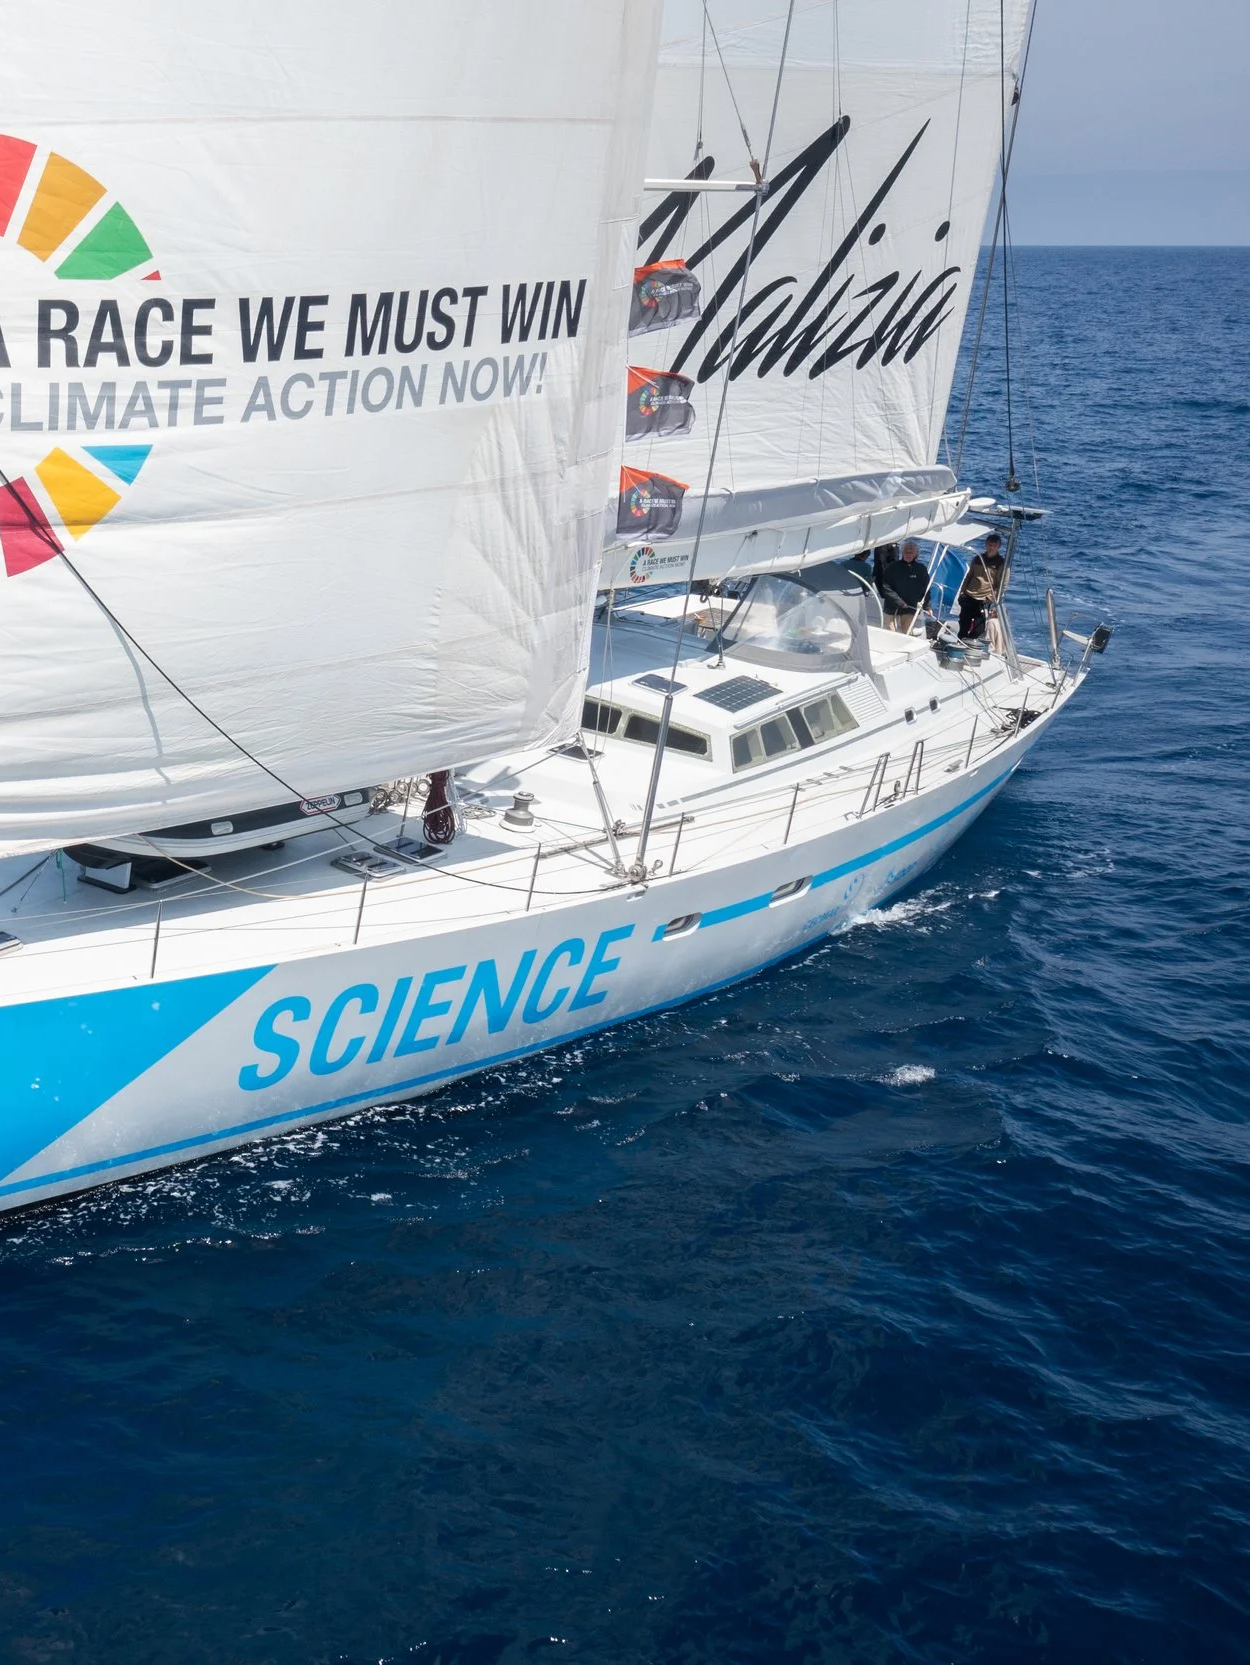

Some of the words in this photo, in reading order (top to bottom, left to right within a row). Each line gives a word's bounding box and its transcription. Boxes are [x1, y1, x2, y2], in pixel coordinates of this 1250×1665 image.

[37, 298, 216, 369] RACE
[238, 295, 328, 364] WE
[345, 286, 487, 356] MUST
[500, 279, 587, 343] WIN
[241, 365, 425, 425] ACTION
[438, 352, 548, 401] NOW!
[238, 924, 635, 1091] SCIENCE
